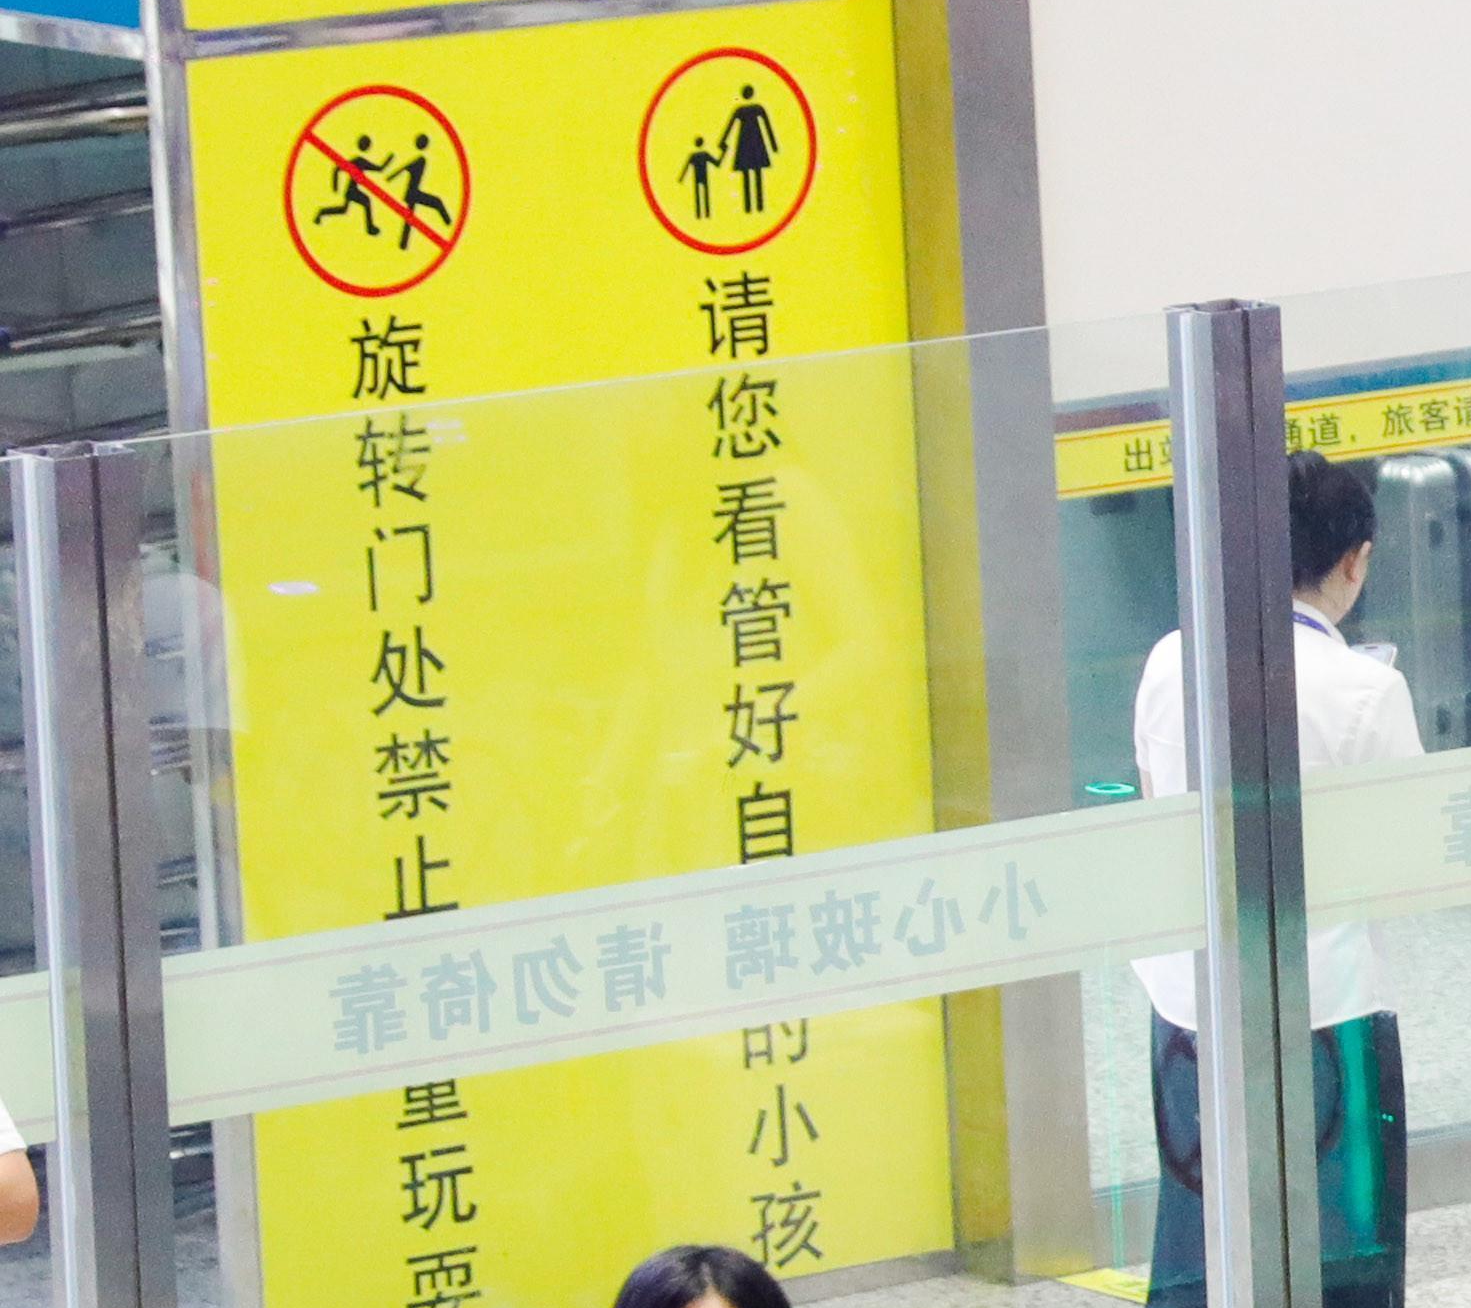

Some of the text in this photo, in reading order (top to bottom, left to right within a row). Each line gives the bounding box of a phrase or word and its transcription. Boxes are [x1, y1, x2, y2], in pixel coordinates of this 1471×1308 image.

[697, 272, 825, 1275] 请您看管好自的小孩
